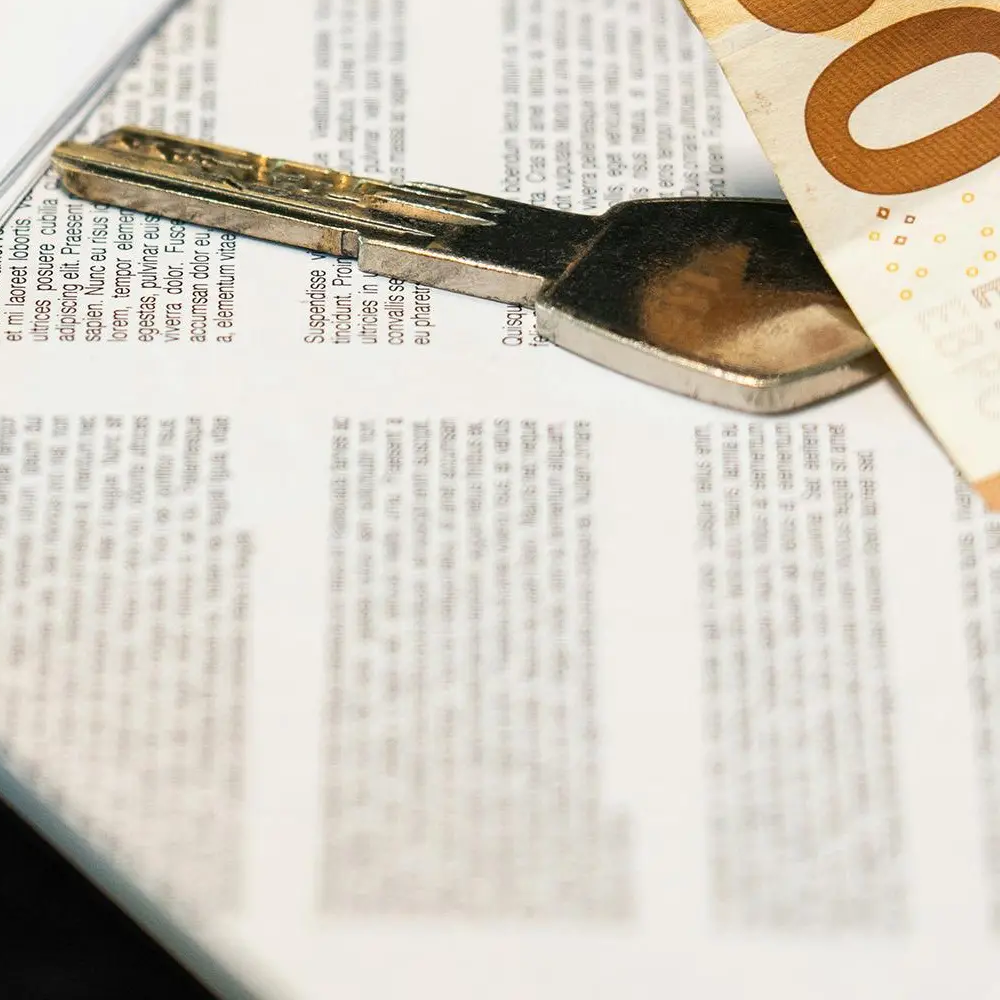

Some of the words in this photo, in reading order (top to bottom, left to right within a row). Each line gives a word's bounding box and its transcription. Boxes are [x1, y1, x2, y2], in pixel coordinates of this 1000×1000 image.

[7, 216, 31, 261] lobortis.
[38, 199, 58, 236] cubilia
[60, 204, 83, 255] Praesent
[87, 216, 109, 244] risus
[113, 209, 135, 251] elemen
[164, 218, 186, 254] Fusce
[36, 243, 57, 291] posuere
[90, 247, 107, 262] eu
[137, 244, 162, 289] pulvinar
[189, 250, 210, 280] dolor
[215, 233, 237, 261] vitae
[5, 265, 28, 307] laoreet
[59, 260, 80, 280] elit.
[84, 265, 106, 296] Nunc
[111, 257, 136, 299] tempor
[162, 262, 184, 295] dolor.
[331, 257, 353, 287] Proin
[358, 284, 378, 294] in
[55, 283, 84, 342] adipiscing
[190, 283, 208, 342] accumsan
[213, 264, 235, 328] elementum
[304, 270, 330, 343] Suspendisse
[409, 284, 436, 328] pharetr
[4, 311, 24, 326] mi
[5, 330, 23, 342] et
[30, 299, 52, 341] ultrices
[82, 300, 107, 342] sapien.
[107, 306, 132, 342] lorem,
[137, 293, 160, 342] egestas,
[160, 302, 182, 343] viverra
[332, 293, 352, 344] tincidunt.
[357, 300, 378, 344] ultricies
[384, 294, 405, 345] convallis
[414, 331, 431, 345] eu
[500, 303, 528, 346] Quisqu
